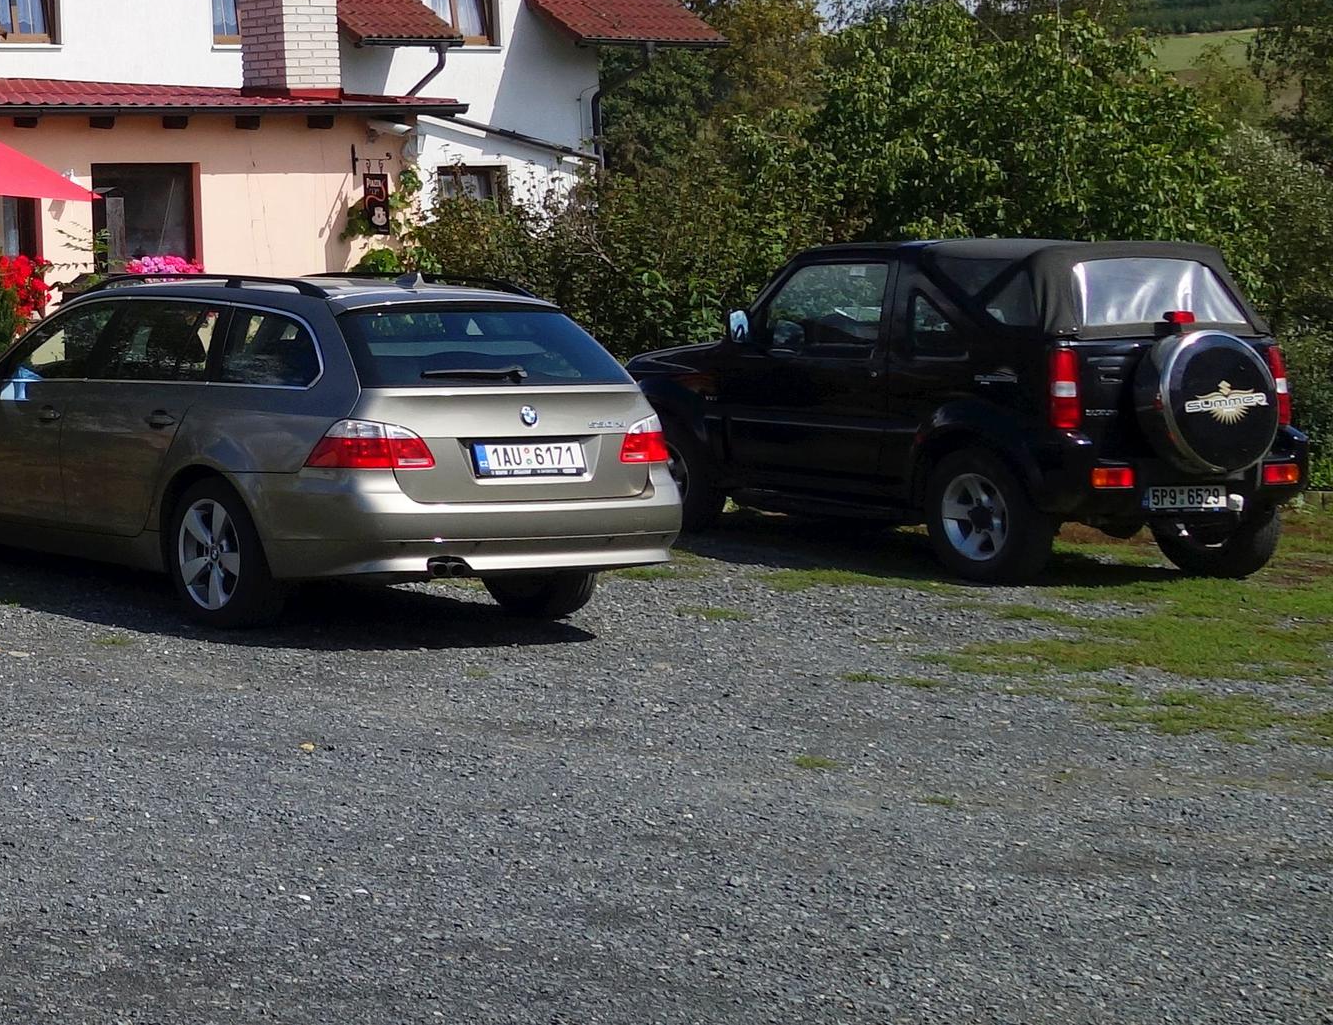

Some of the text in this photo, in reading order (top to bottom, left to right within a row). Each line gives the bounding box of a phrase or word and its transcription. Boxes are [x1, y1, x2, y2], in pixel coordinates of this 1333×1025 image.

[492, 447, 522, 467] 1AU
[534, 446, 575, 466] 6171
[1152, 487, 1220, 506] 5P9 6529
